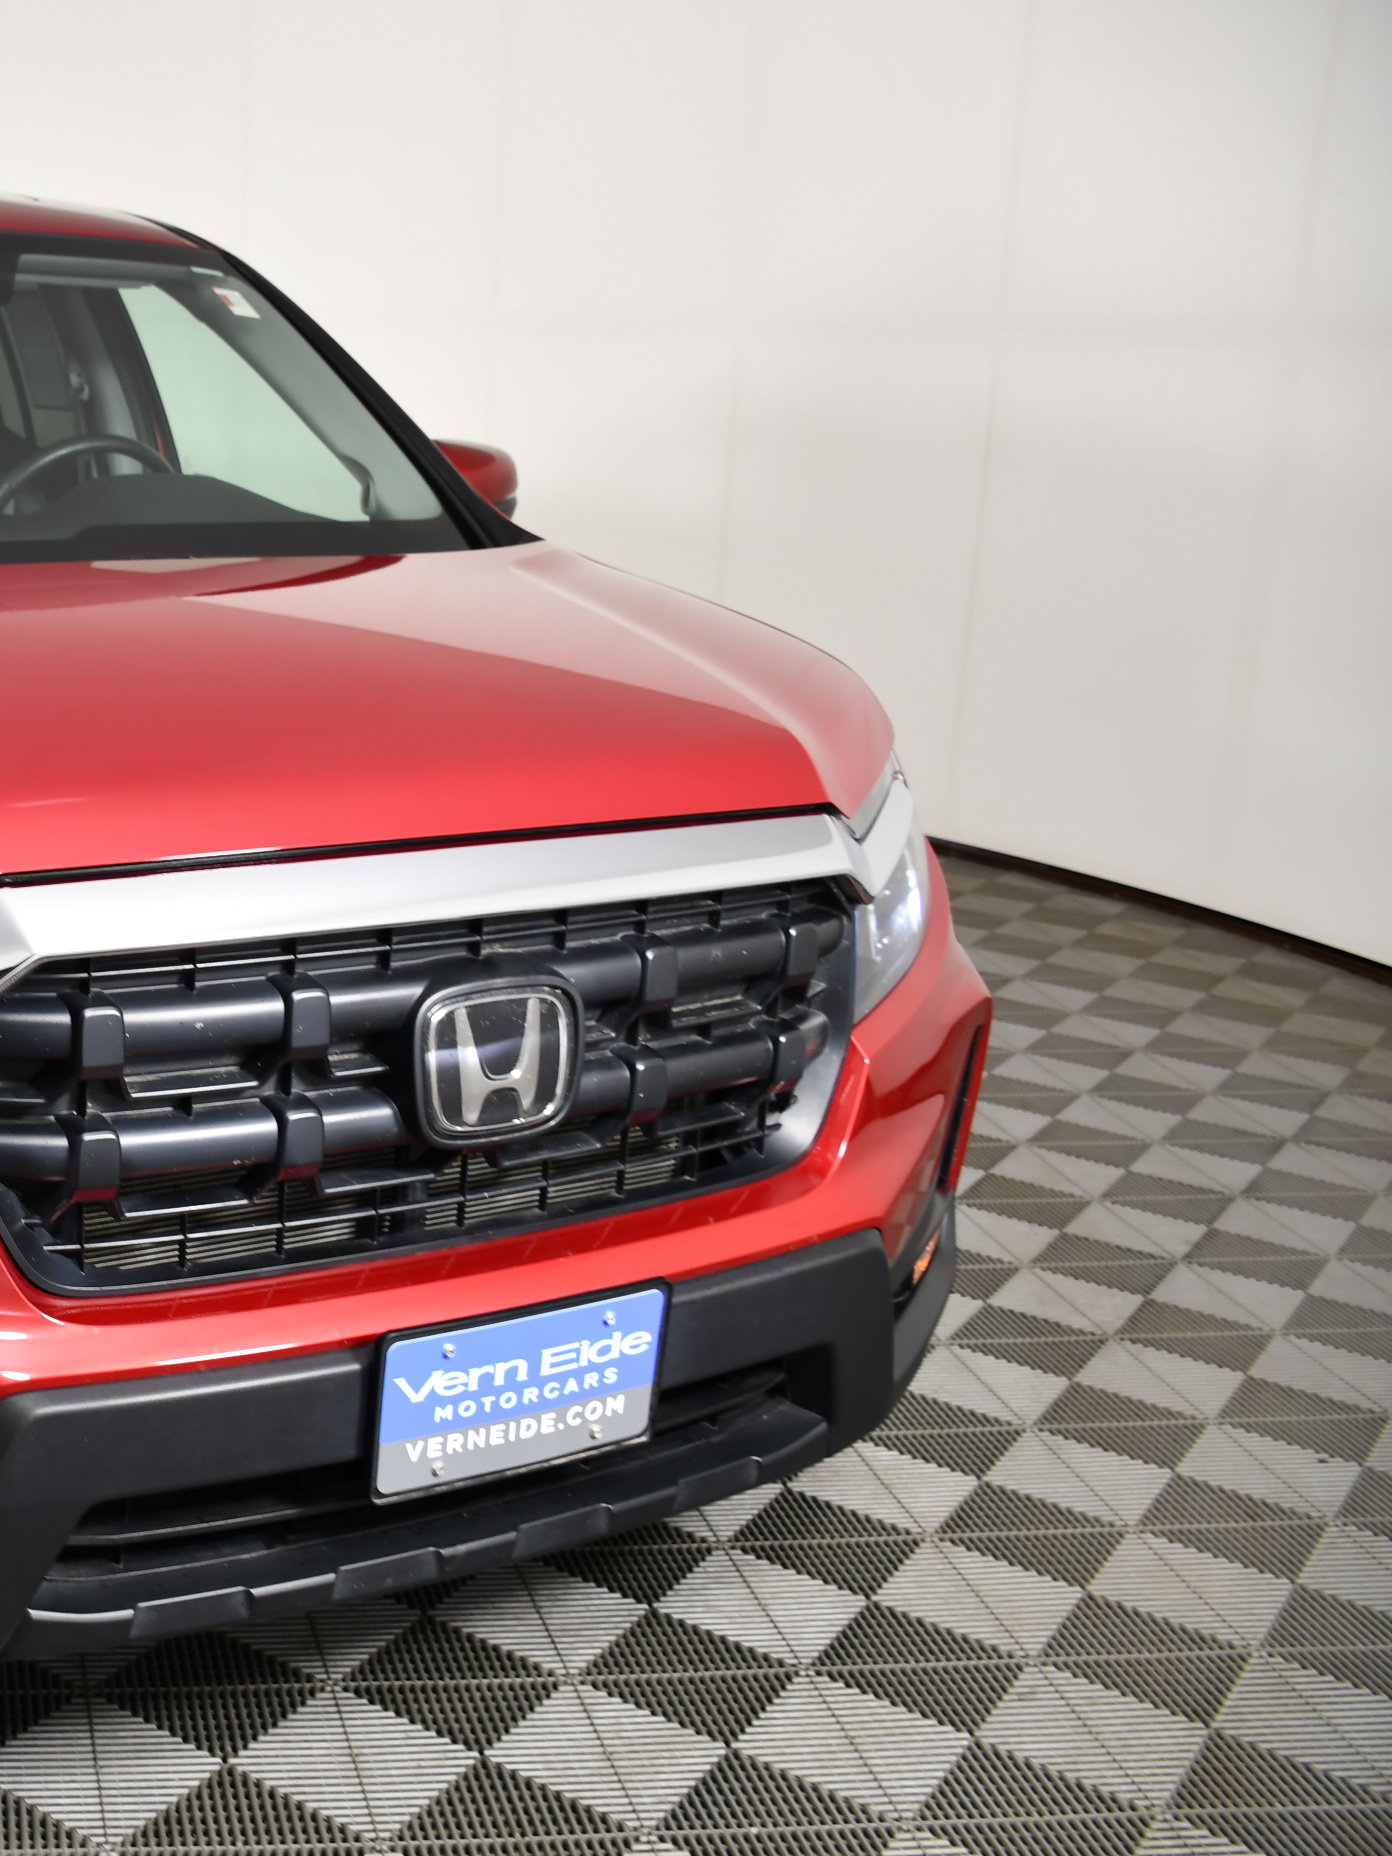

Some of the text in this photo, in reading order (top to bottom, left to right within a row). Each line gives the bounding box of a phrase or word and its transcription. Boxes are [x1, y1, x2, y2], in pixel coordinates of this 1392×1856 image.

[393, 1330, 652, 1403] Vern Eide
[434, 1367, 619, 1423] MOTORCARS
[405, 1394, 626, 1462] VERNEIDE.COM
